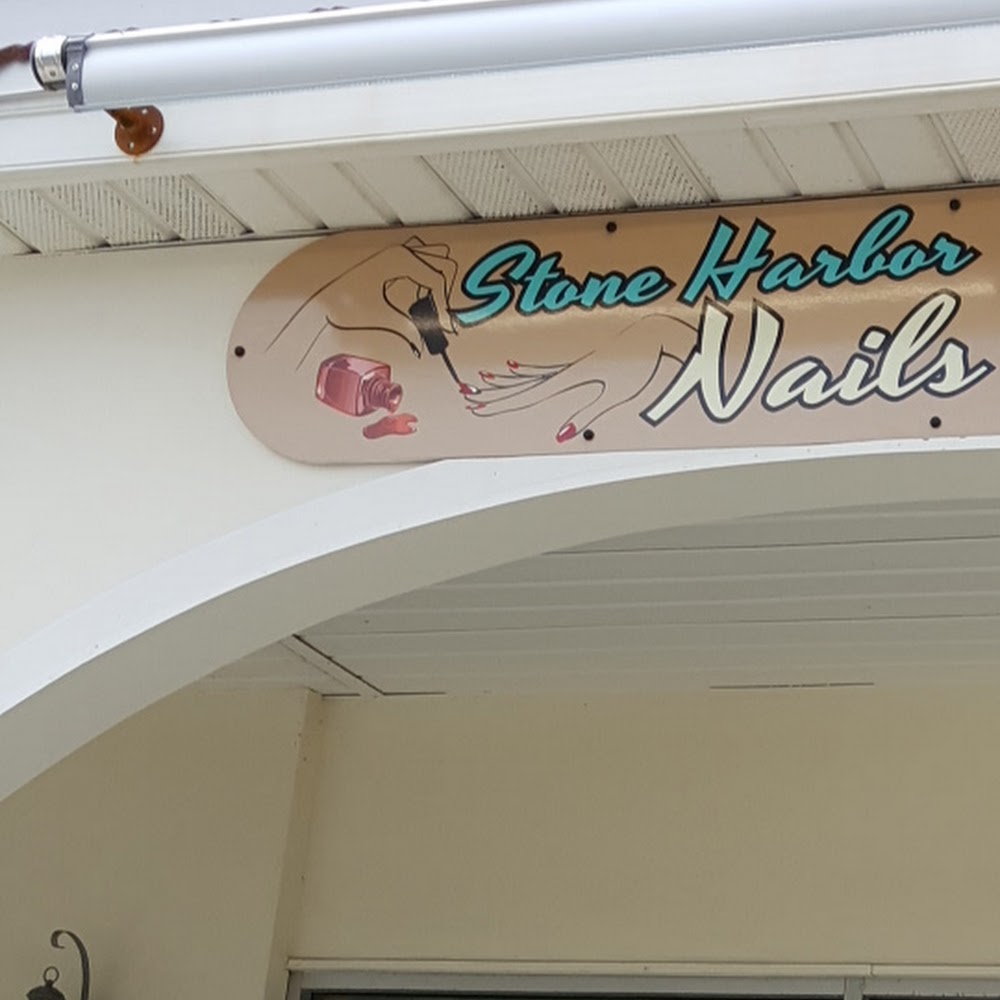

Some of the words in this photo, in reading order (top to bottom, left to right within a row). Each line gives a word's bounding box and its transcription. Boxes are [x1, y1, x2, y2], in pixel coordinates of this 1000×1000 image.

[450, 239, 675, 328] Stone
[677, 205, 982, 305] Harbor
[639, 290, 995, 427] Nails
